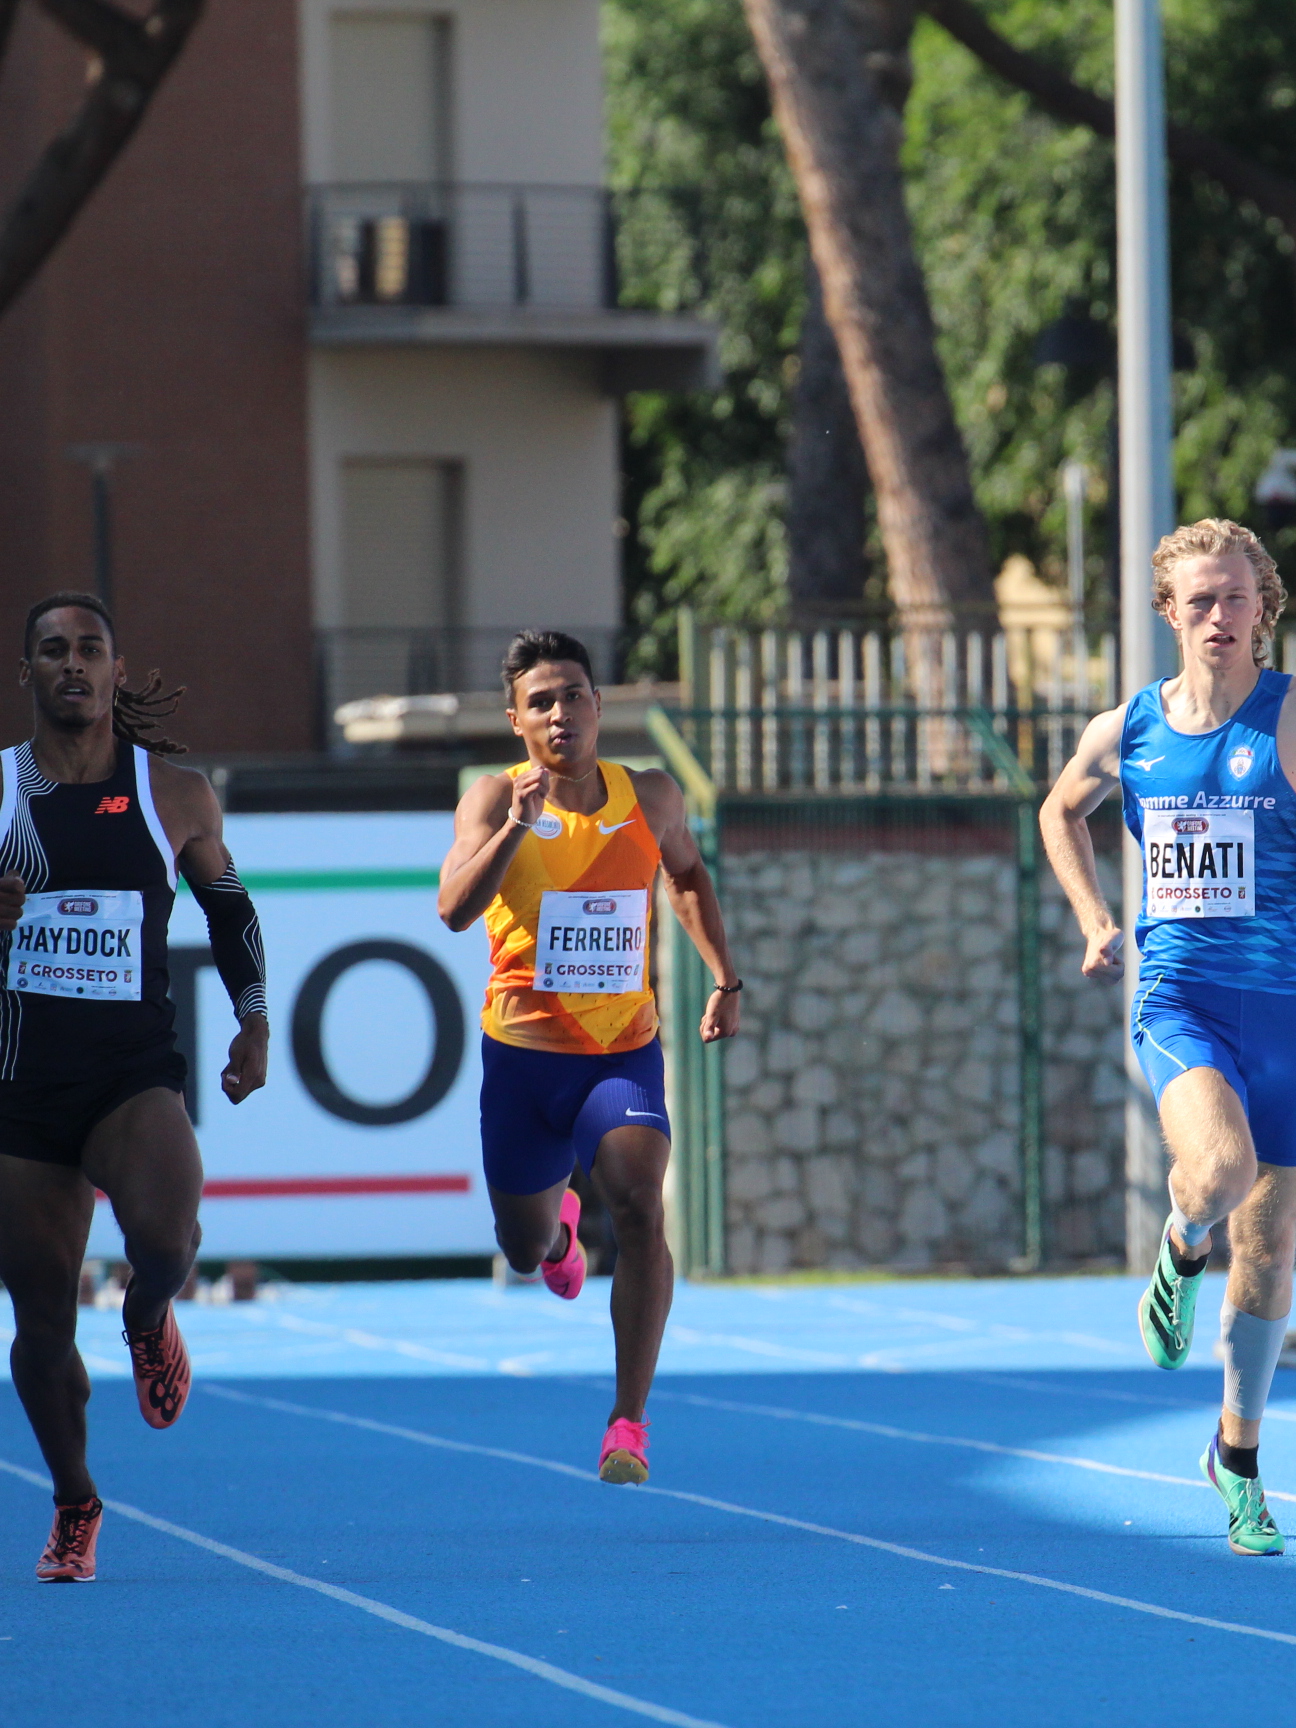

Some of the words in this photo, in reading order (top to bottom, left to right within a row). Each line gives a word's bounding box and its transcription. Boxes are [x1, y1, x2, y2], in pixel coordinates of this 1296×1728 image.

[1193, 791, 1276, 809] Azzurre
[1150, 842, 1244, 879] BENATI
[1157, 887, 1232, 900] GROSSETO
[17, 925, 132, 957] HAYDOCK
[549, 926, 642, 952] FERREIRO
[31, 964, 117, 983] GROSSETO
[556, 964, 632, 977] GROSSETO
